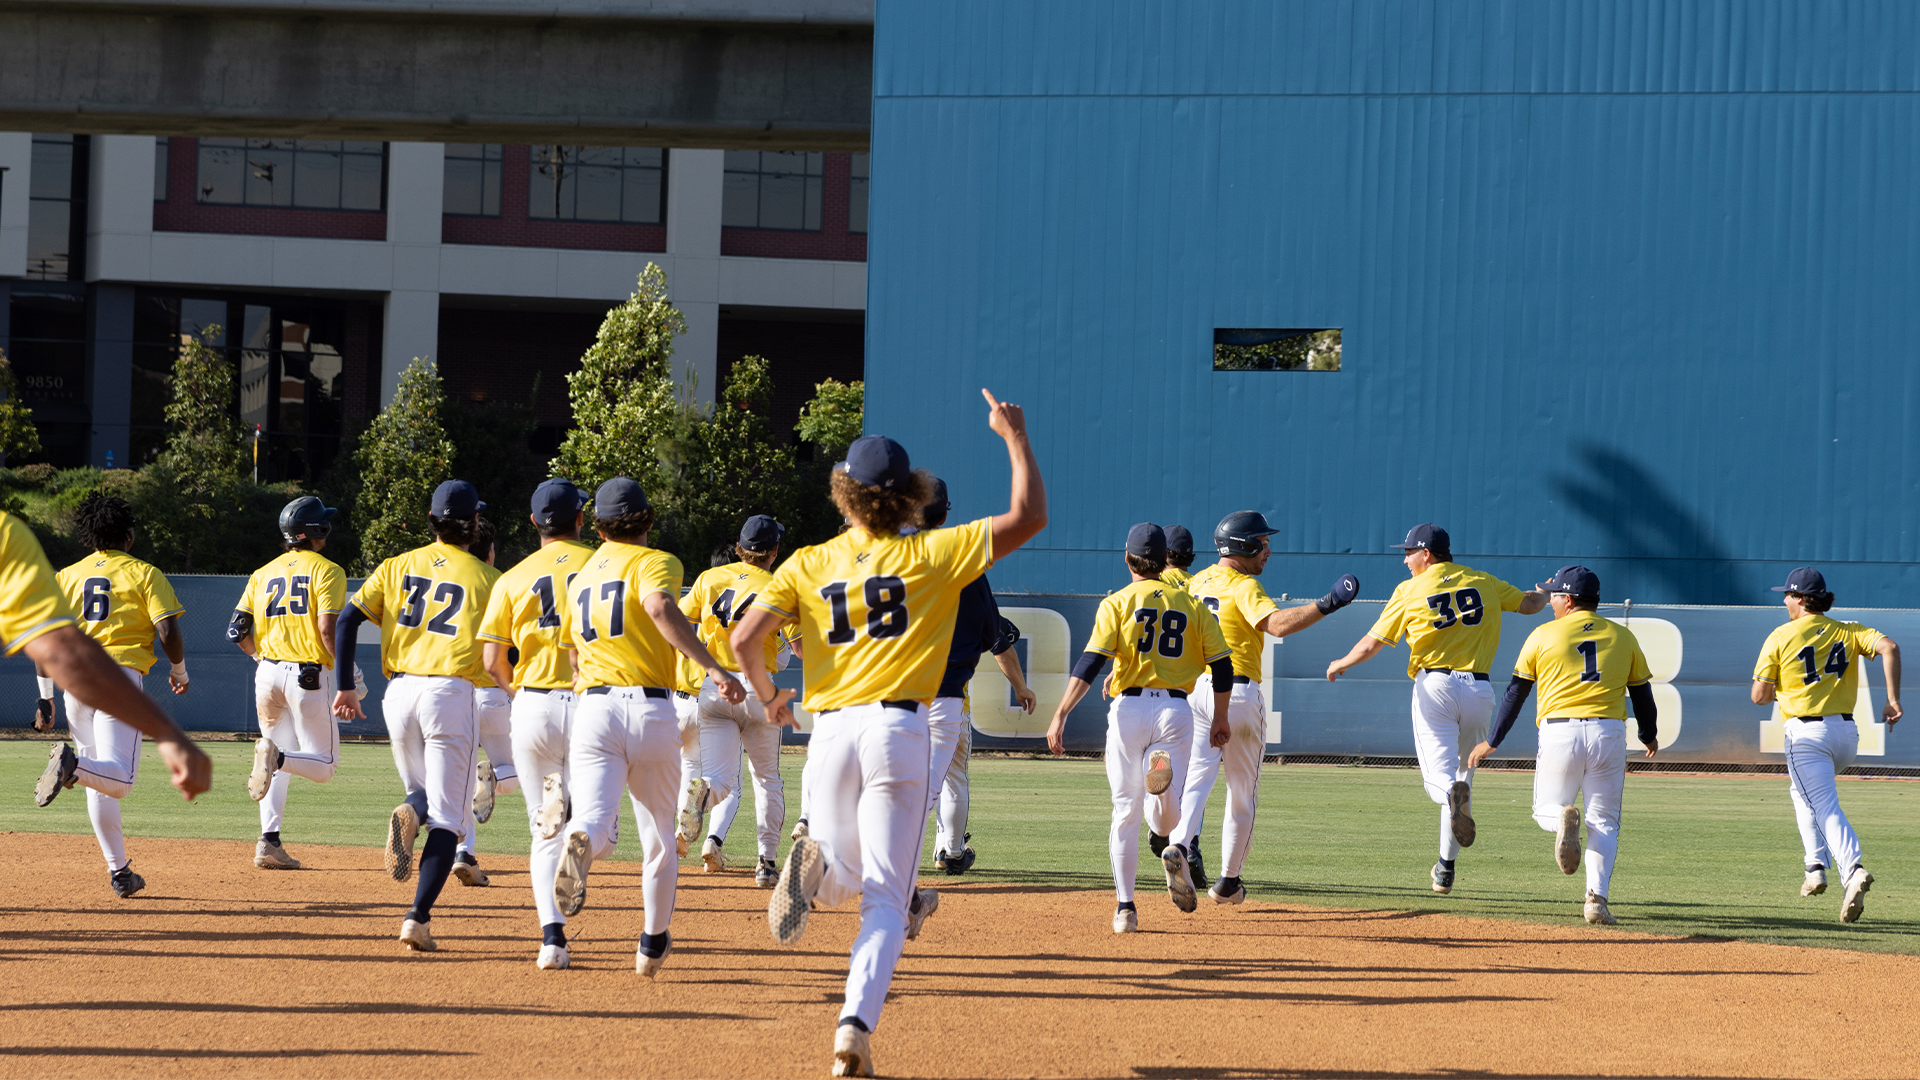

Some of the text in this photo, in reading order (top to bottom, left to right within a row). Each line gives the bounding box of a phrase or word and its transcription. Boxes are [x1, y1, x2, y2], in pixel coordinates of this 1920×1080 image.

[83, 576, 111, 622] 6
[265, 575, 311, 618] 25
[397, 574, 466, 637] 32
[530, 571, 579, 629] 1
[577, 579, 626, 645] 17
[819, 574, 909, 647] 18
[1426, 587, 1484, 631] 39
[1134, 607, 1188, 659] 38
[1576, 640, 1602, 683] 1
[1797, 640, 1849, 686] 14
